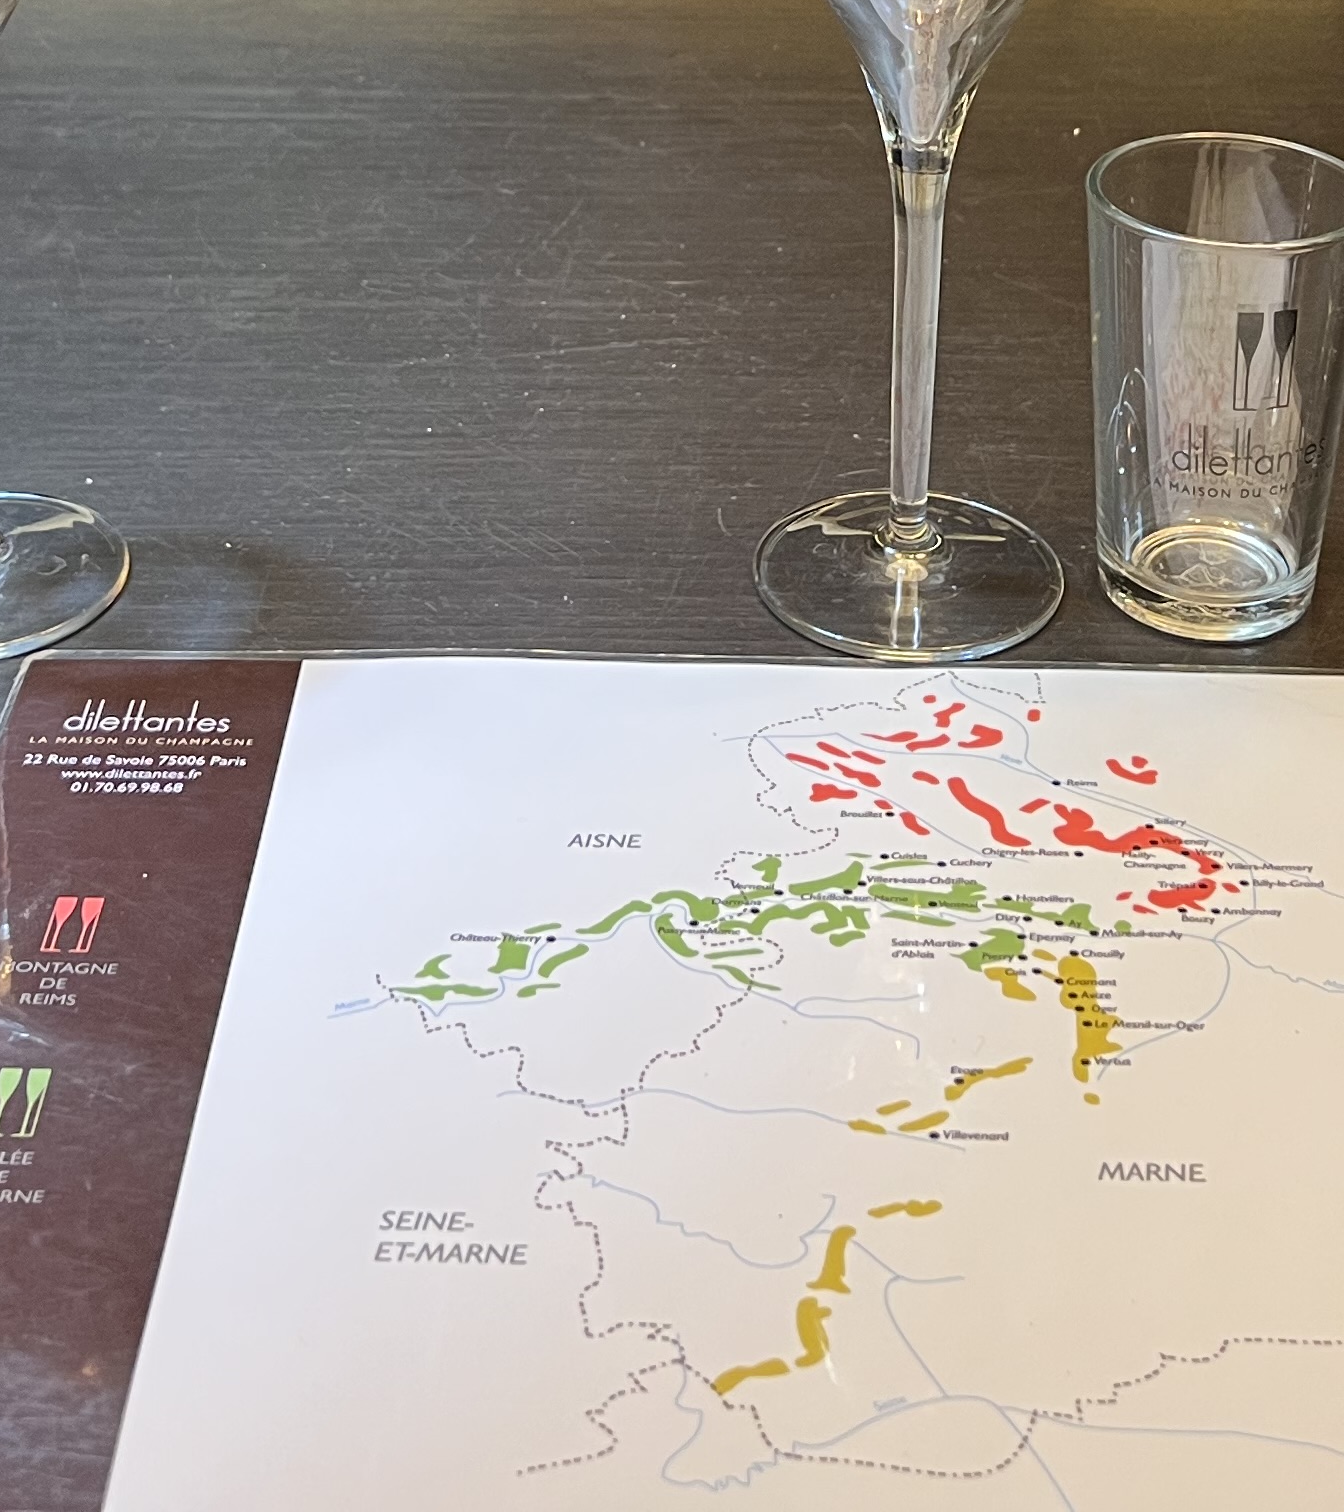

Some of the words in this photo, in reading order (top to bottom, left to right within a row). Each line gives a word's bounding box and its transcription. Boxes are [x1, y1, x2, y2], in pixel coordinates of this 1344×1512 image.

[1169, 480, 1231, 499] MAISON
[1240, 488, 1262, 499] DU
[63, 699, 231, 733] dilettantes
[29, 736, 48, 745] LA
[55, 736, 119, 745] MAISON
[125, 736, 148, 746] DU
[155, 737, 255, 747] CHAMPAGNE
[22, 753, 43, 765] 22
[46, 753, 78, 766] Rue
[82, 754, 101, 766] de
[105, 754, 154, 767] Savoie
[158, 755, 206, 767] 75006
[209, 756, 248, 767] Paris
[60, 769, 202, 780] www.dilettantes.fr
[70, 781, 184, 793] 01.70.69.98.68
[567, 833, 642, 849] AISNE
[981, 847, 1070, 859] Chigny-les-Roses
[949, 858, 993, 869] Cuchery
[1123, 860, 1187, 871] Champagne
[449, 932, 542, 945] Château-Thierry
[891, 938, 966, 949] Saint-Martin-
[1080, 949, 1125, 961] Chouilly
[39, 977, 67, 990] DE
[18, 992, 77, 1007] REIMS
[942, 1130, 1010, 1142] Villevenard
[1097, 1160, 1207, 1184] MARNE
[378, 1210, 474, 1233] SEINE-
[373, 1241, 528, 1266] ET-MARNE
